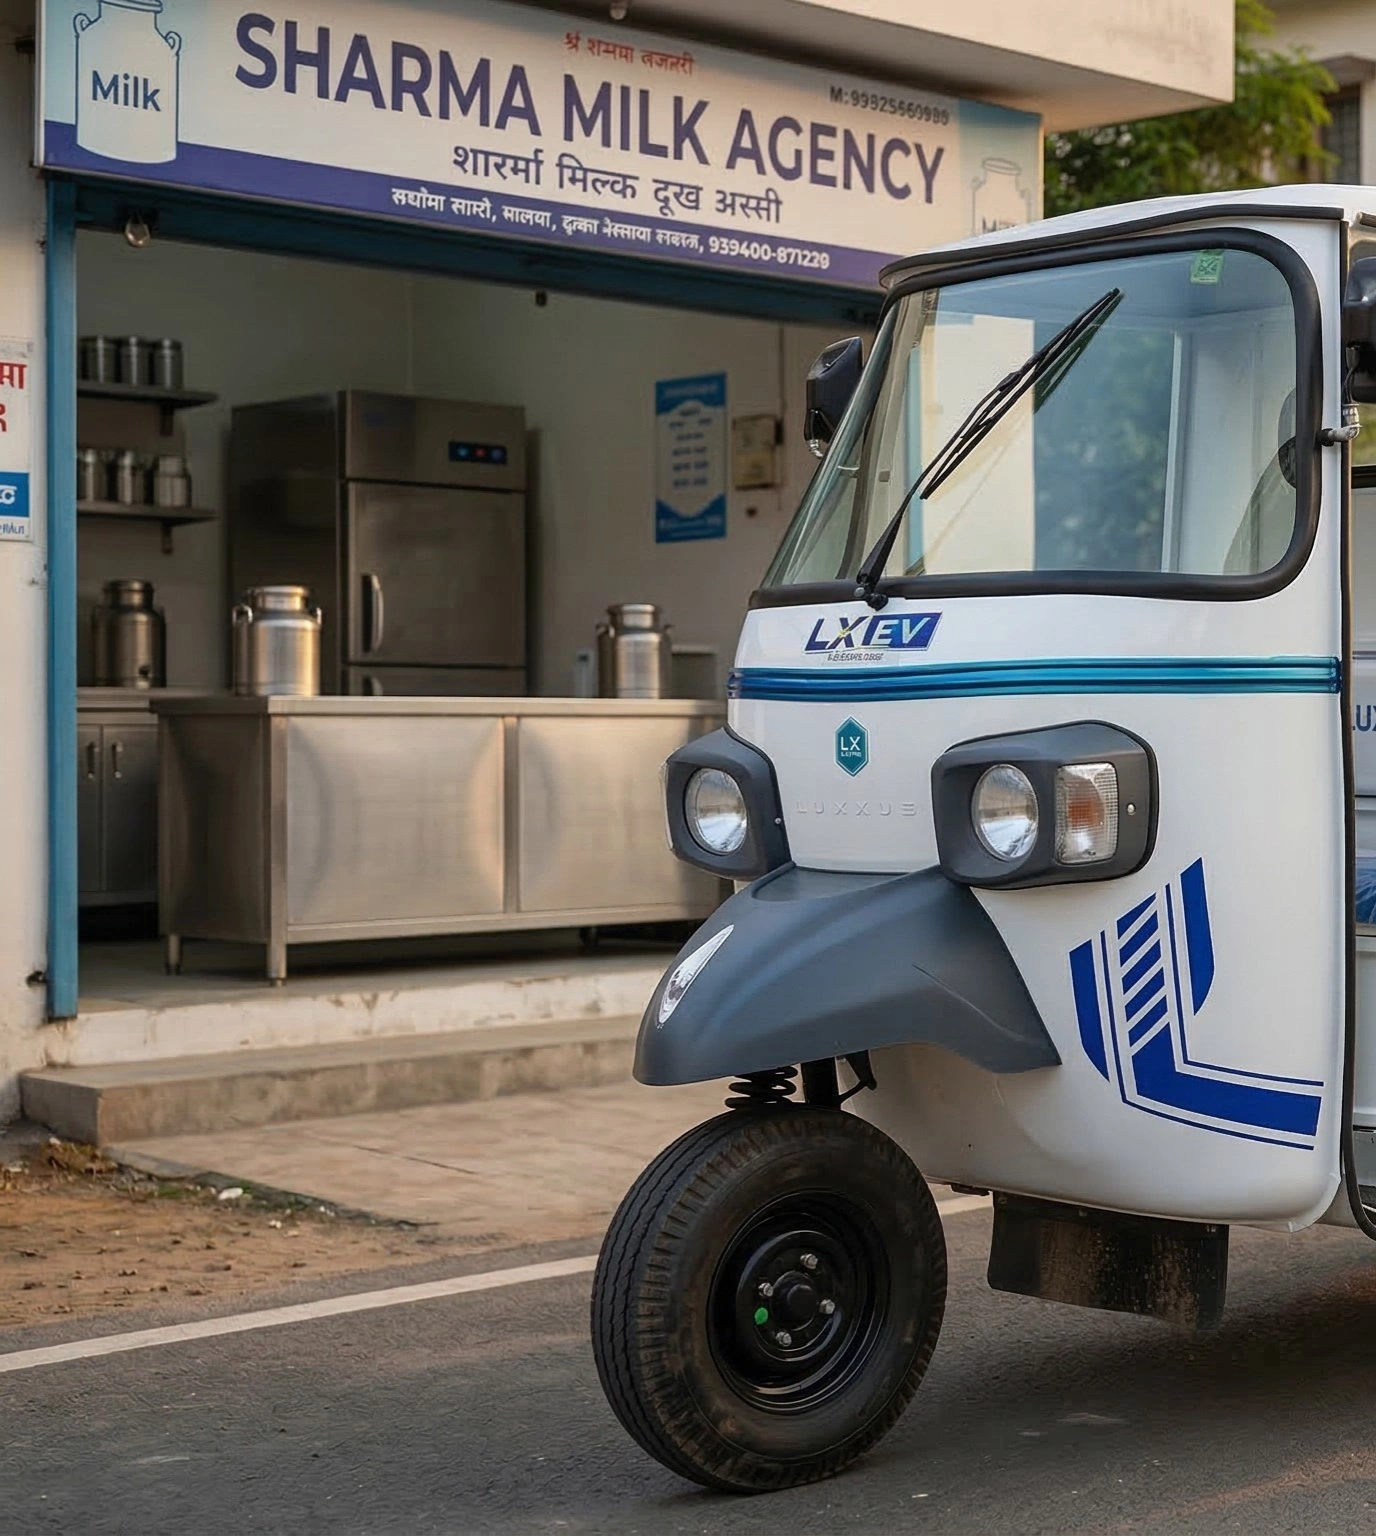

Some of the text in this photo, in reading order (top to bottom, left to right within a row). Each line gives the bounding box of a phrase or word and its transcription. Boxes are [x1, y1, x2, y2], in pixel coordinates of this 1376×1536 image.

[92, 69, 161, 112] Milk
[235, 13, 944, 204] SHARMA MILK AGENCY
[556, 152, 640, 199] मिल्क
[714, 187, 783, 224] अस्सी
[840, 736, 861, 751] LX
